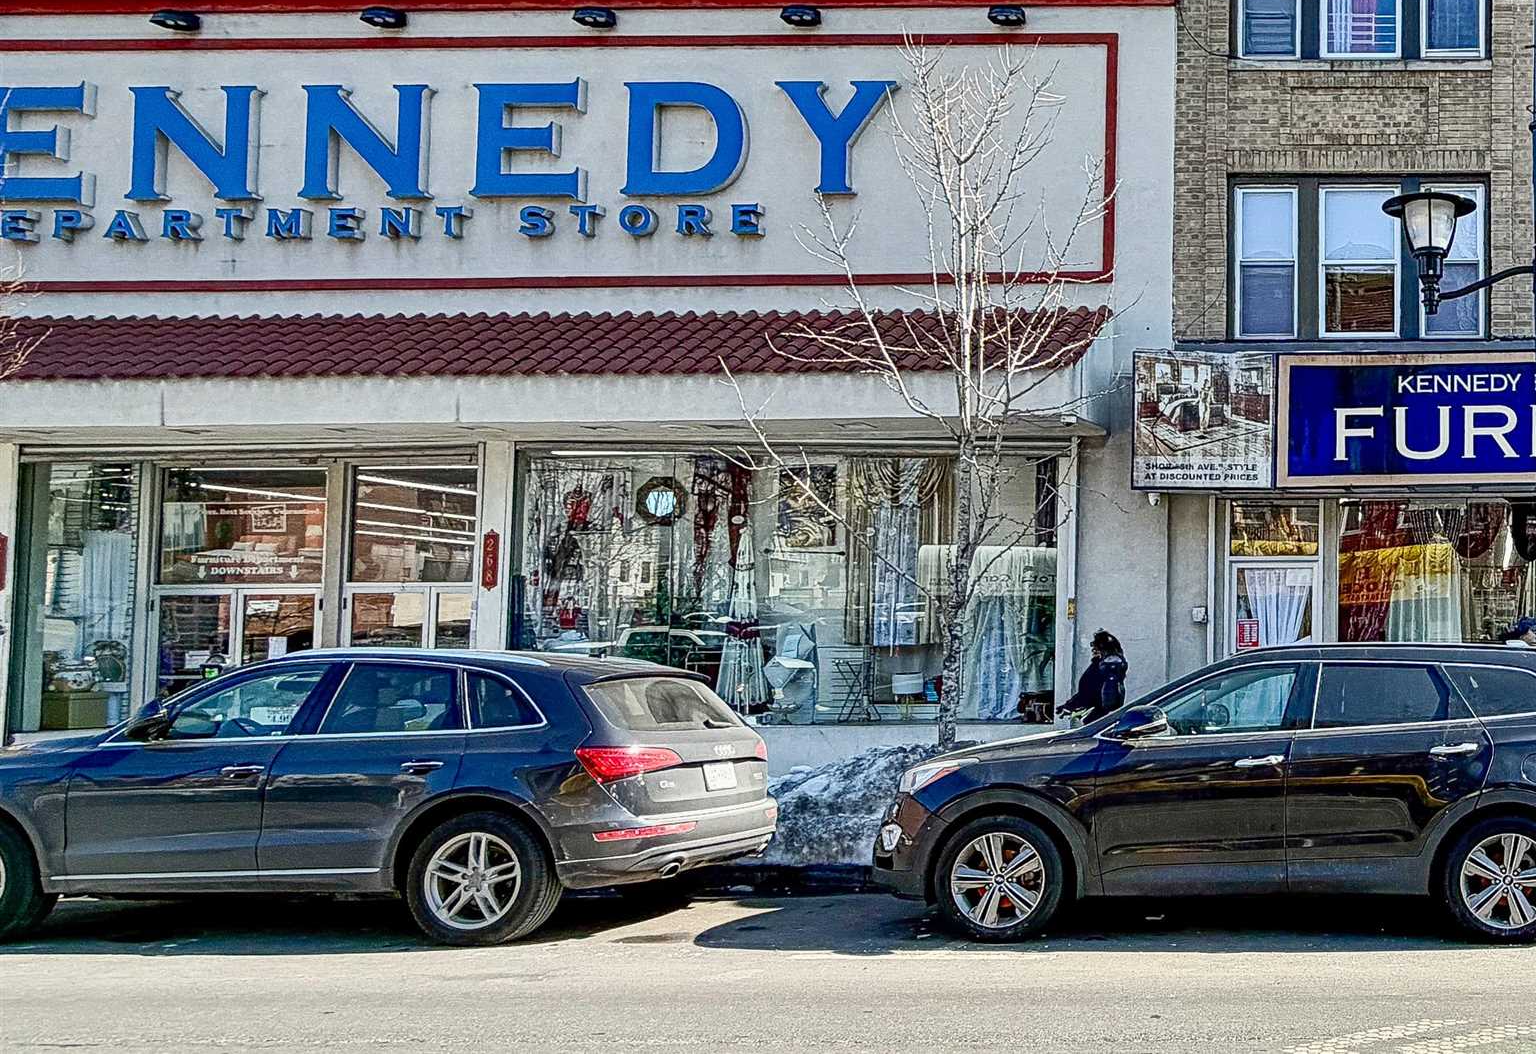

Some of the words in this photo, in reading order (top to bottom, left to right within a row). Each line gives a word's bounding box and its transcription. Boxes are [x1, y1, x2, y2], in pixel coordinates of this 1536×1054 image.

[0, 77, 899, 205] ENNEDY
[0, 206, 474, 242] EPARTMENT
[519, 203, 767, 238] STORE
[1398, 373, 1521, 393] KENNEDY
[1226, 463, 1258, 471] STYLE
[1224, 473, 1259, 482] PRICES
[210, 566, 284, 575] DOWNSTAIRS
